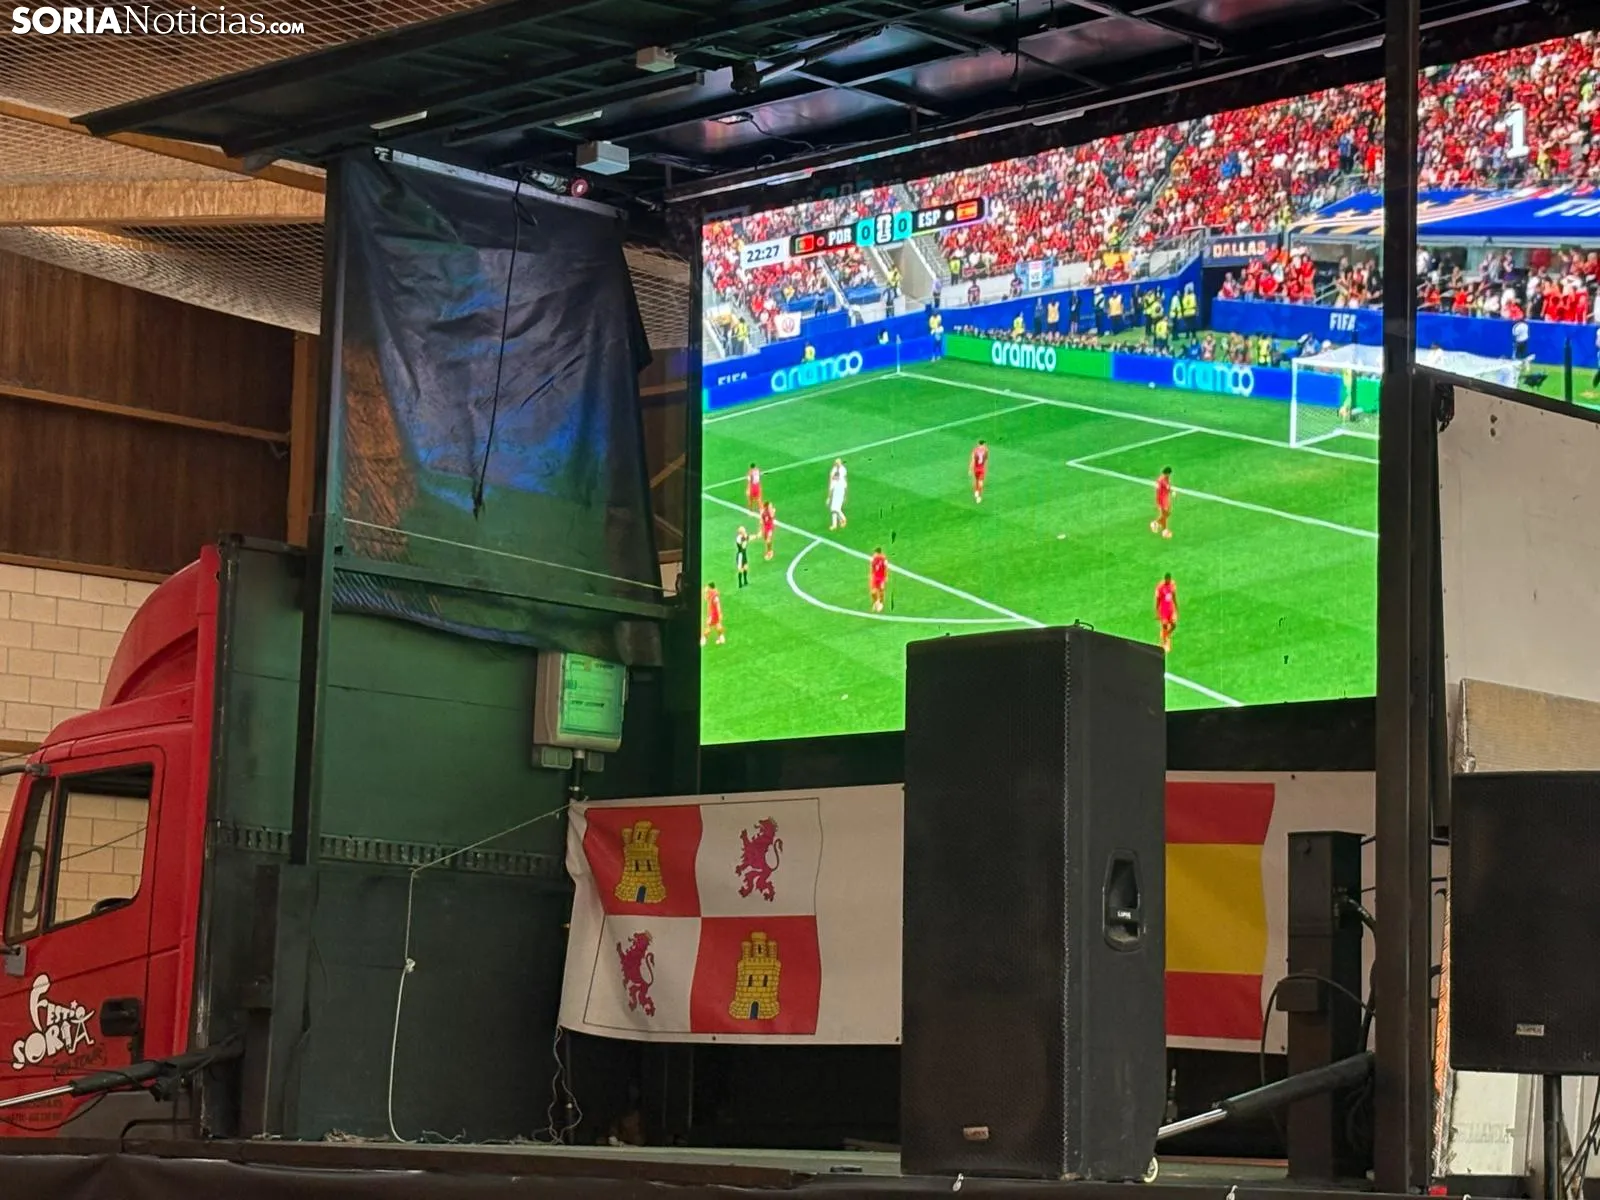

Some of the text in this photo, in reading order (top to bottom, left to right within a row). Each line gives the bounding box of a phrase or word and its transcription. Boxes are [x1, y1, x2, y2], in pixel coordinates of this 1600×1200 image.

[1503, 103, 1529, 158] 1
[746, 210, 941, 263] 22:27 POR 0 0 ESP
[1213, 240, 1266, 258] DALLAS
[1329, 312, 1356, 331] FIFA
[991, 340, 1057, 372] aramco
[12, 1006, 95, 1070] SORIA
